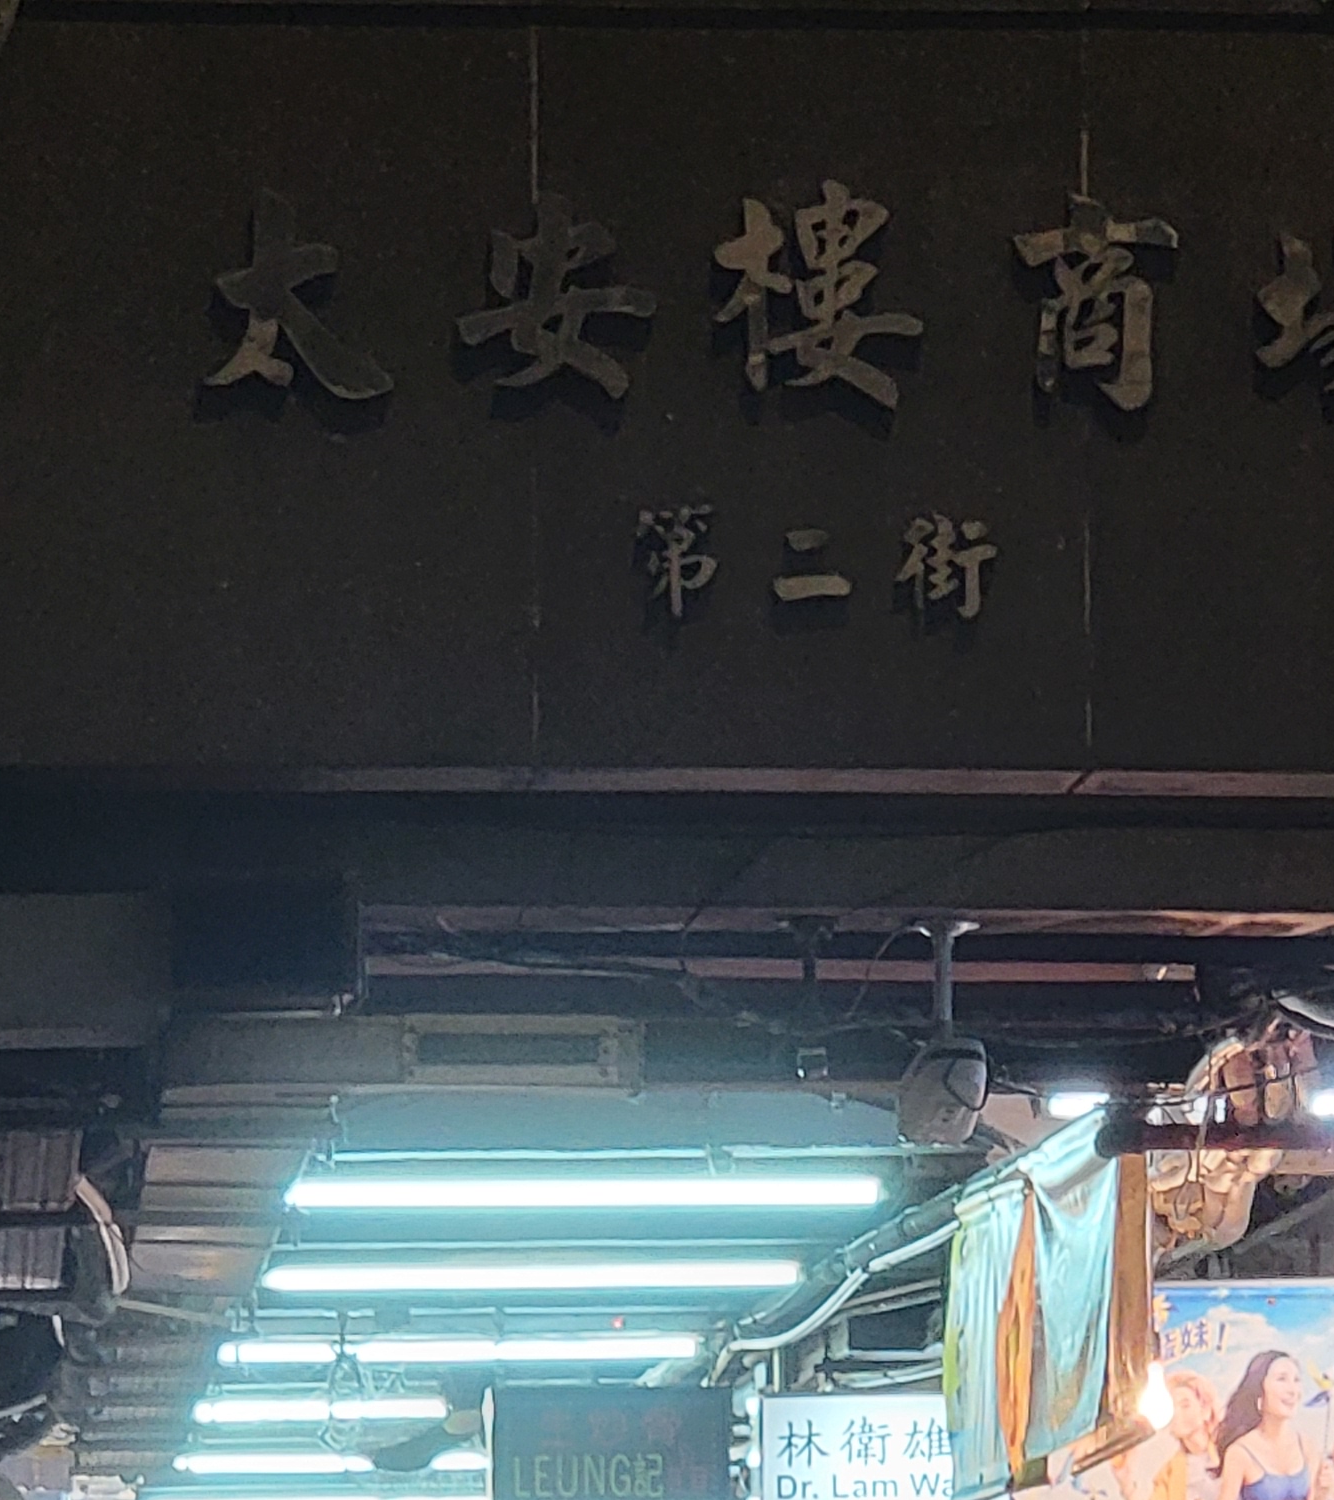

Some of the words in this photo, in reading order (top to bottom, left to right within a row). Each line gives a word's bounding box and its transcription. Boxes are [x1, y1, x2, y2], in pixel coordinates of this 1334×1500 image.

[637, 504, 997, 617] 第二街
[777, 1416, 953, 1468] 林衛雄
[513, 1453, 664, 1498] LEUNG記
[777, 1475, 819, 1499] Dr.
[832, 1474, 898, 1498] Lam
